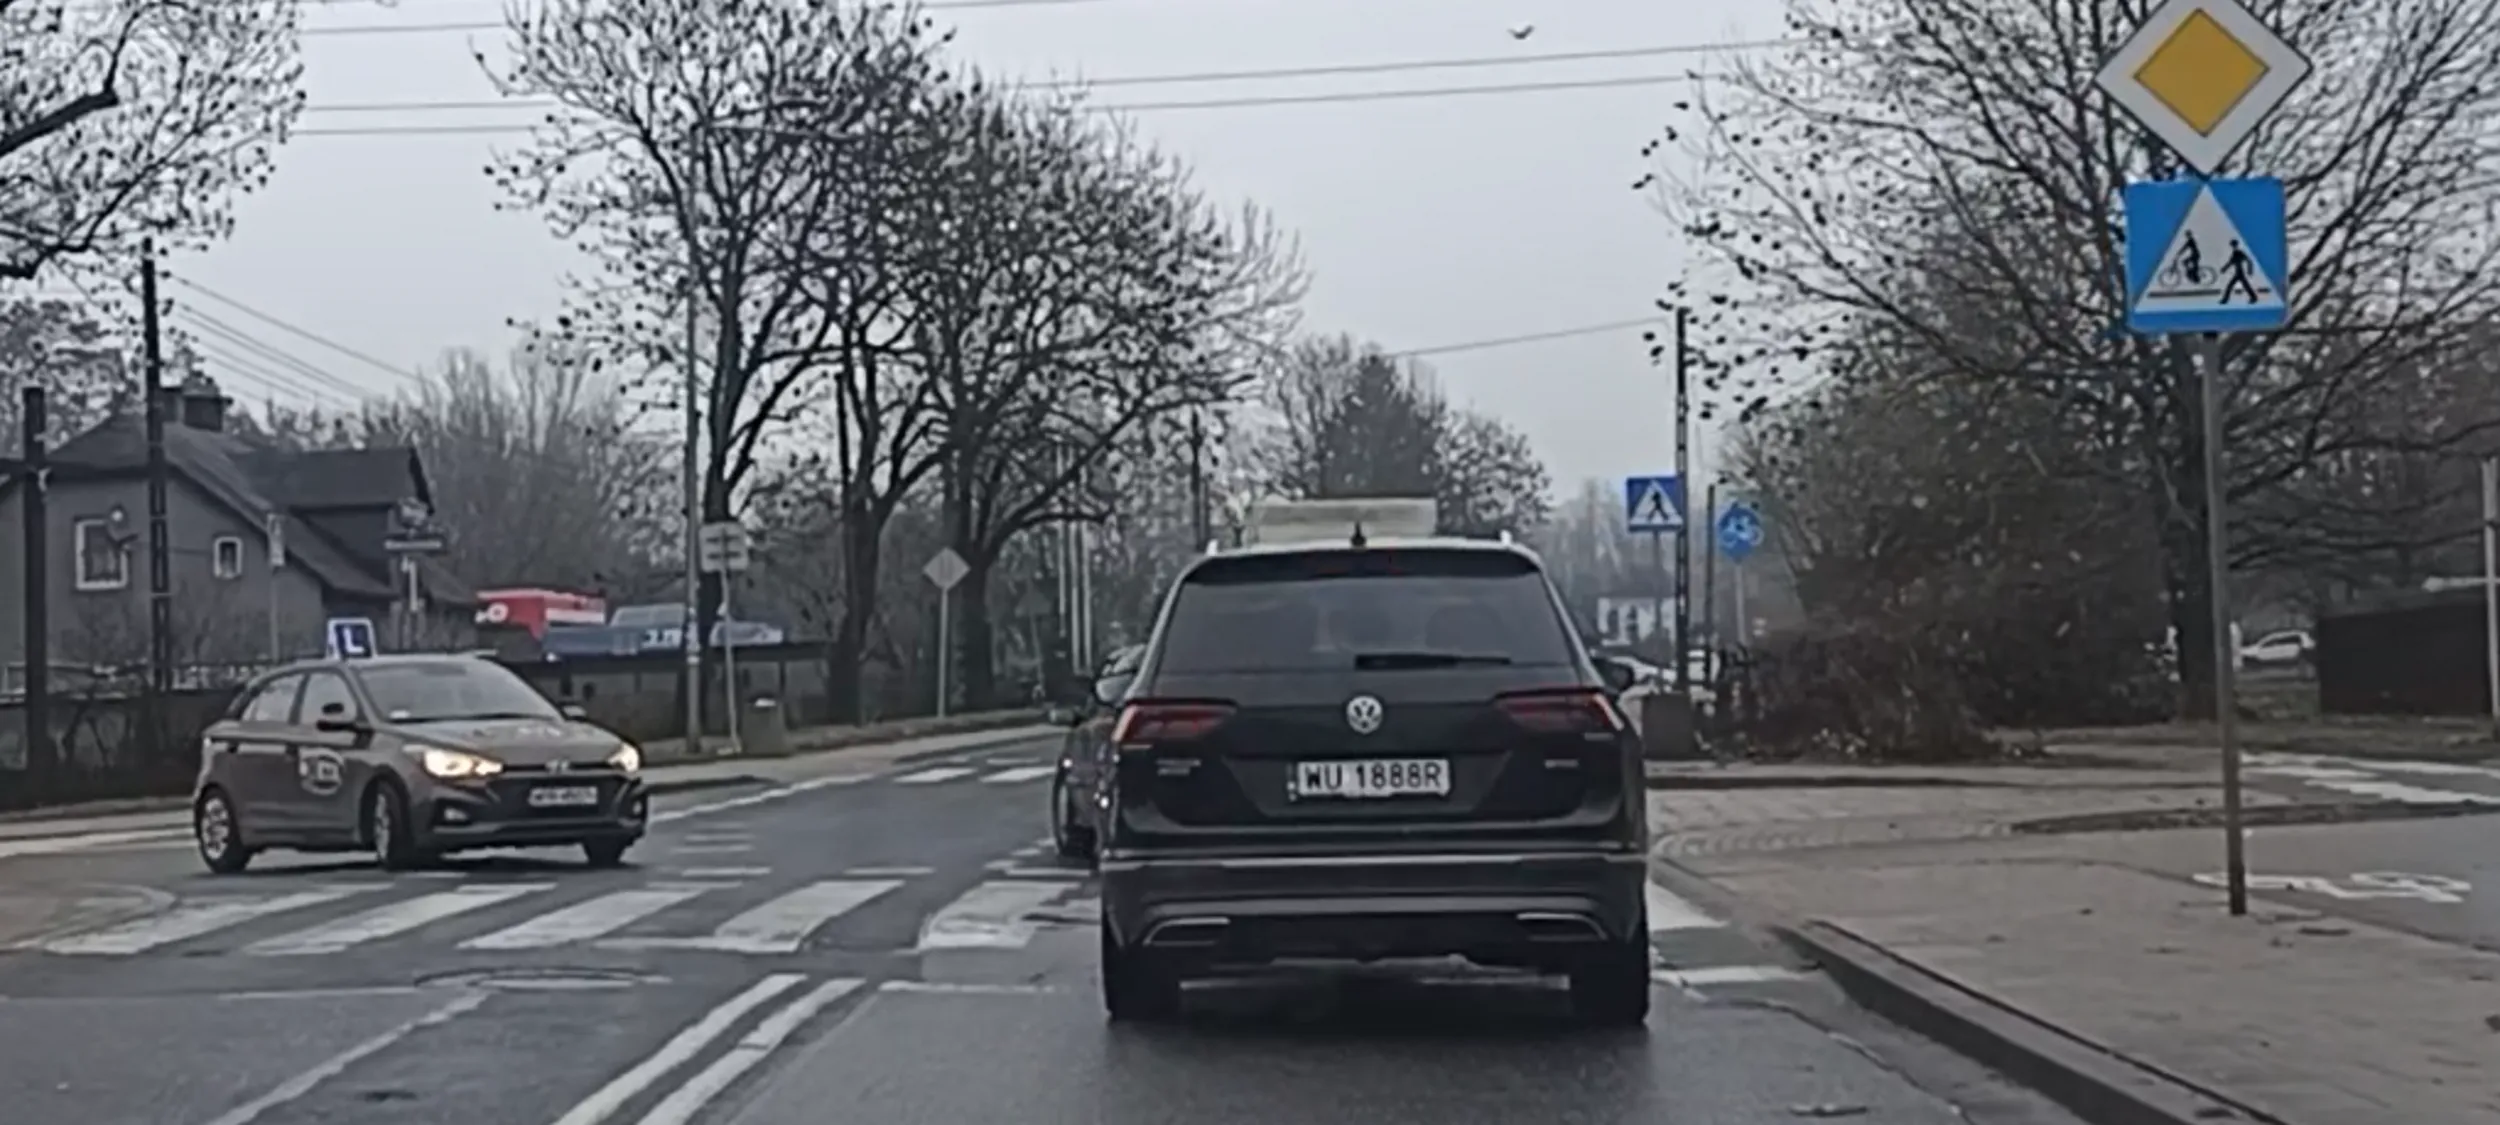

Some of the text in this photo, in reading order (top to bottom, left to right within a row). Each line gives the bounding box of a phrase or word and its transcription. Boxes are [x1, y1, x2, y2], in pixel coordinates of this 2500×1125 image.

[343, 626, 365, 654] L
[1304, 761, 1442, 790] WU 1888R
